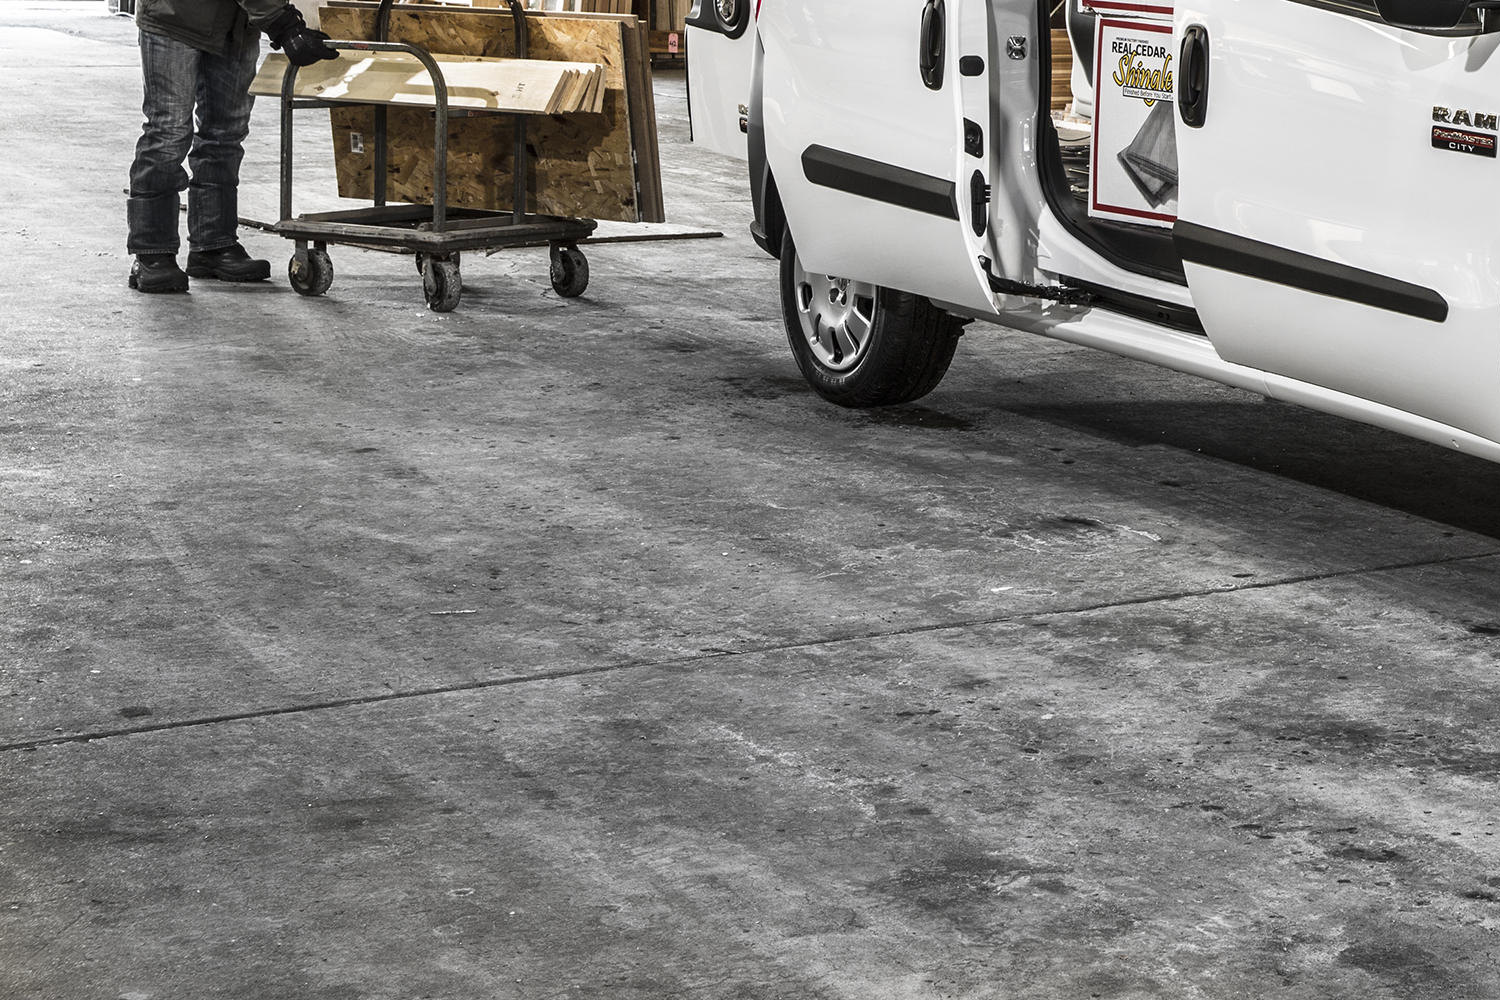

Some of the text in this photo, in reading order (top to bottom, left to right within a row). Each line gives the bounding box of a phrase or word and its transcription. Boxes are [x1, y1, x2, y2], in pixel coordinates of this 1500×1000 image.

[1112, 41, 1167, 58] REAL CEDAR
[1113, 50, 1173, 107] Shingle
[1124, 87, 1140, 96] Finished
[1140, 90, 1153, 98] Before
[1432, 106, 1500, 131] RAM
[1448, 142, 1475, 152] CITY
